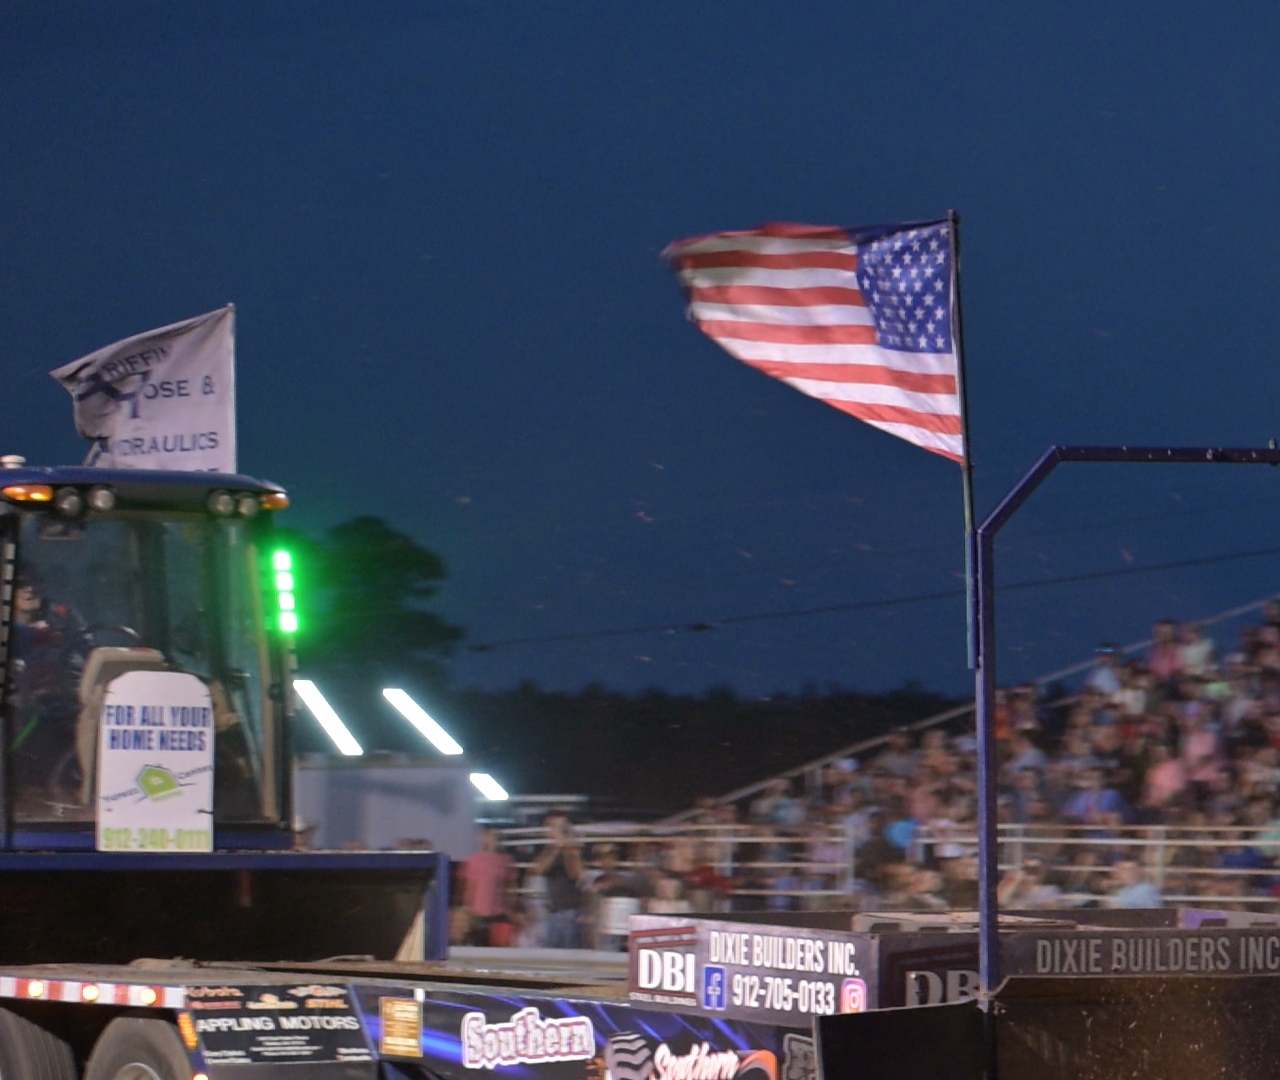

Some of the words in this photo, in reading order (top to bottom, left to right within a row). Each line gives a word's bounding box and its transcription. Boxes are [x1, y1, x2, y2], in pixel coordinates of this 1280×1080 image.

[143, 379, 191, 400] OSE
[118, 431, 219, 457] DRAULICS
[106, 705, 135, 726] FOR
[141, 706, 165, 727] ALL
[171, 707, 211, 728] YOUR
[109, 730, 155, 751] HOME
[159, 731, 207, 752] NEEDS
[637, 949, 696, 993] DBI
[709, 931, 749, 965] DIXIE
[752, 934, 824, 973] BUILDERS
[827, 942, 861, 976] INC.
[1036, 939, 1102, 973] DIXIE
[1111, 937, 1231, 972] BUILDERS
[731, 973, 835, 1014] 912-705-0133
[905, 969, 981, 1007] DB
[196, 1016, 275, 1032] APPLING
[279, 1016, 360, 1031] MOTORS
[463, 1009, 594, 1068] Southern
